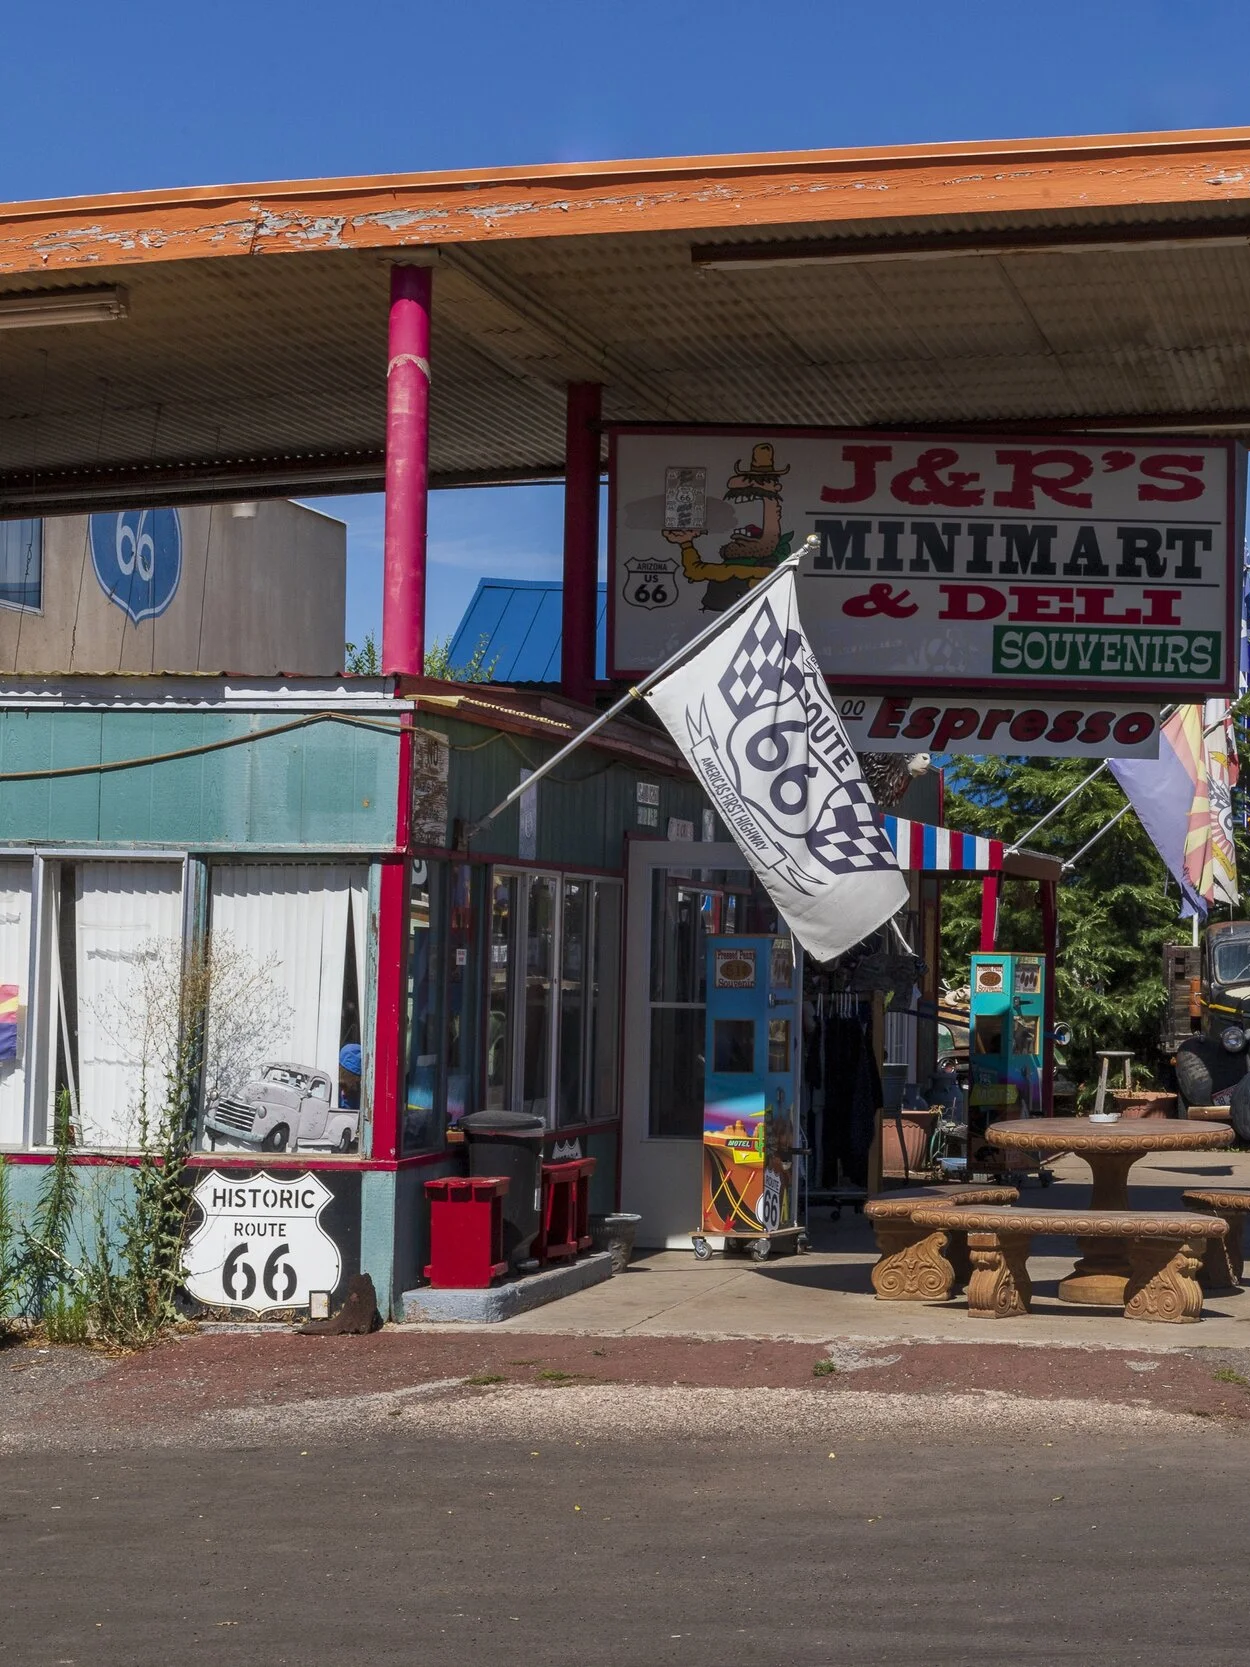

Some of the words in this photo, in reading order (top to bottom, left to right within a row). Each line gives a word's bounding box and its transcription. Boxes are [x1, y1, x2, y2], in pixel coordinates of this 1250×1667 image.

[820, 445, 1206, 510] J&R'S
[813, 519, 1213, 579] MINIMART
[636, 562, 668, 571] ARIZONA
[644, 574, 659, 583] US
[634, 584, 668, 603] 66
[842, 583, 919, 619] &
[938, 584, 1182, 625] DELI
[999, 630, 1213, 674] SOUVENIRS
[867, 696, 1156, 751] Espresso
[745, 720, 818, 815] 66
[701, 757, 731, 799] AMERICAS
[723, 792, 745, 818] FIRST
[735, 814, 769, 851] HIGHWAY
[719, 980, 755, 988] Souvenir
[727, 1139, 750, 1148] MOTEL
[212, 1188, 316, 1209] HISTORIC
[765, 1175, 779, 1190] ROUTE
[763, 1193, 778, 1227] 66
[234, 1222, 287, 1237] ROUTE
[222, 1242, 298, 1301] 66
